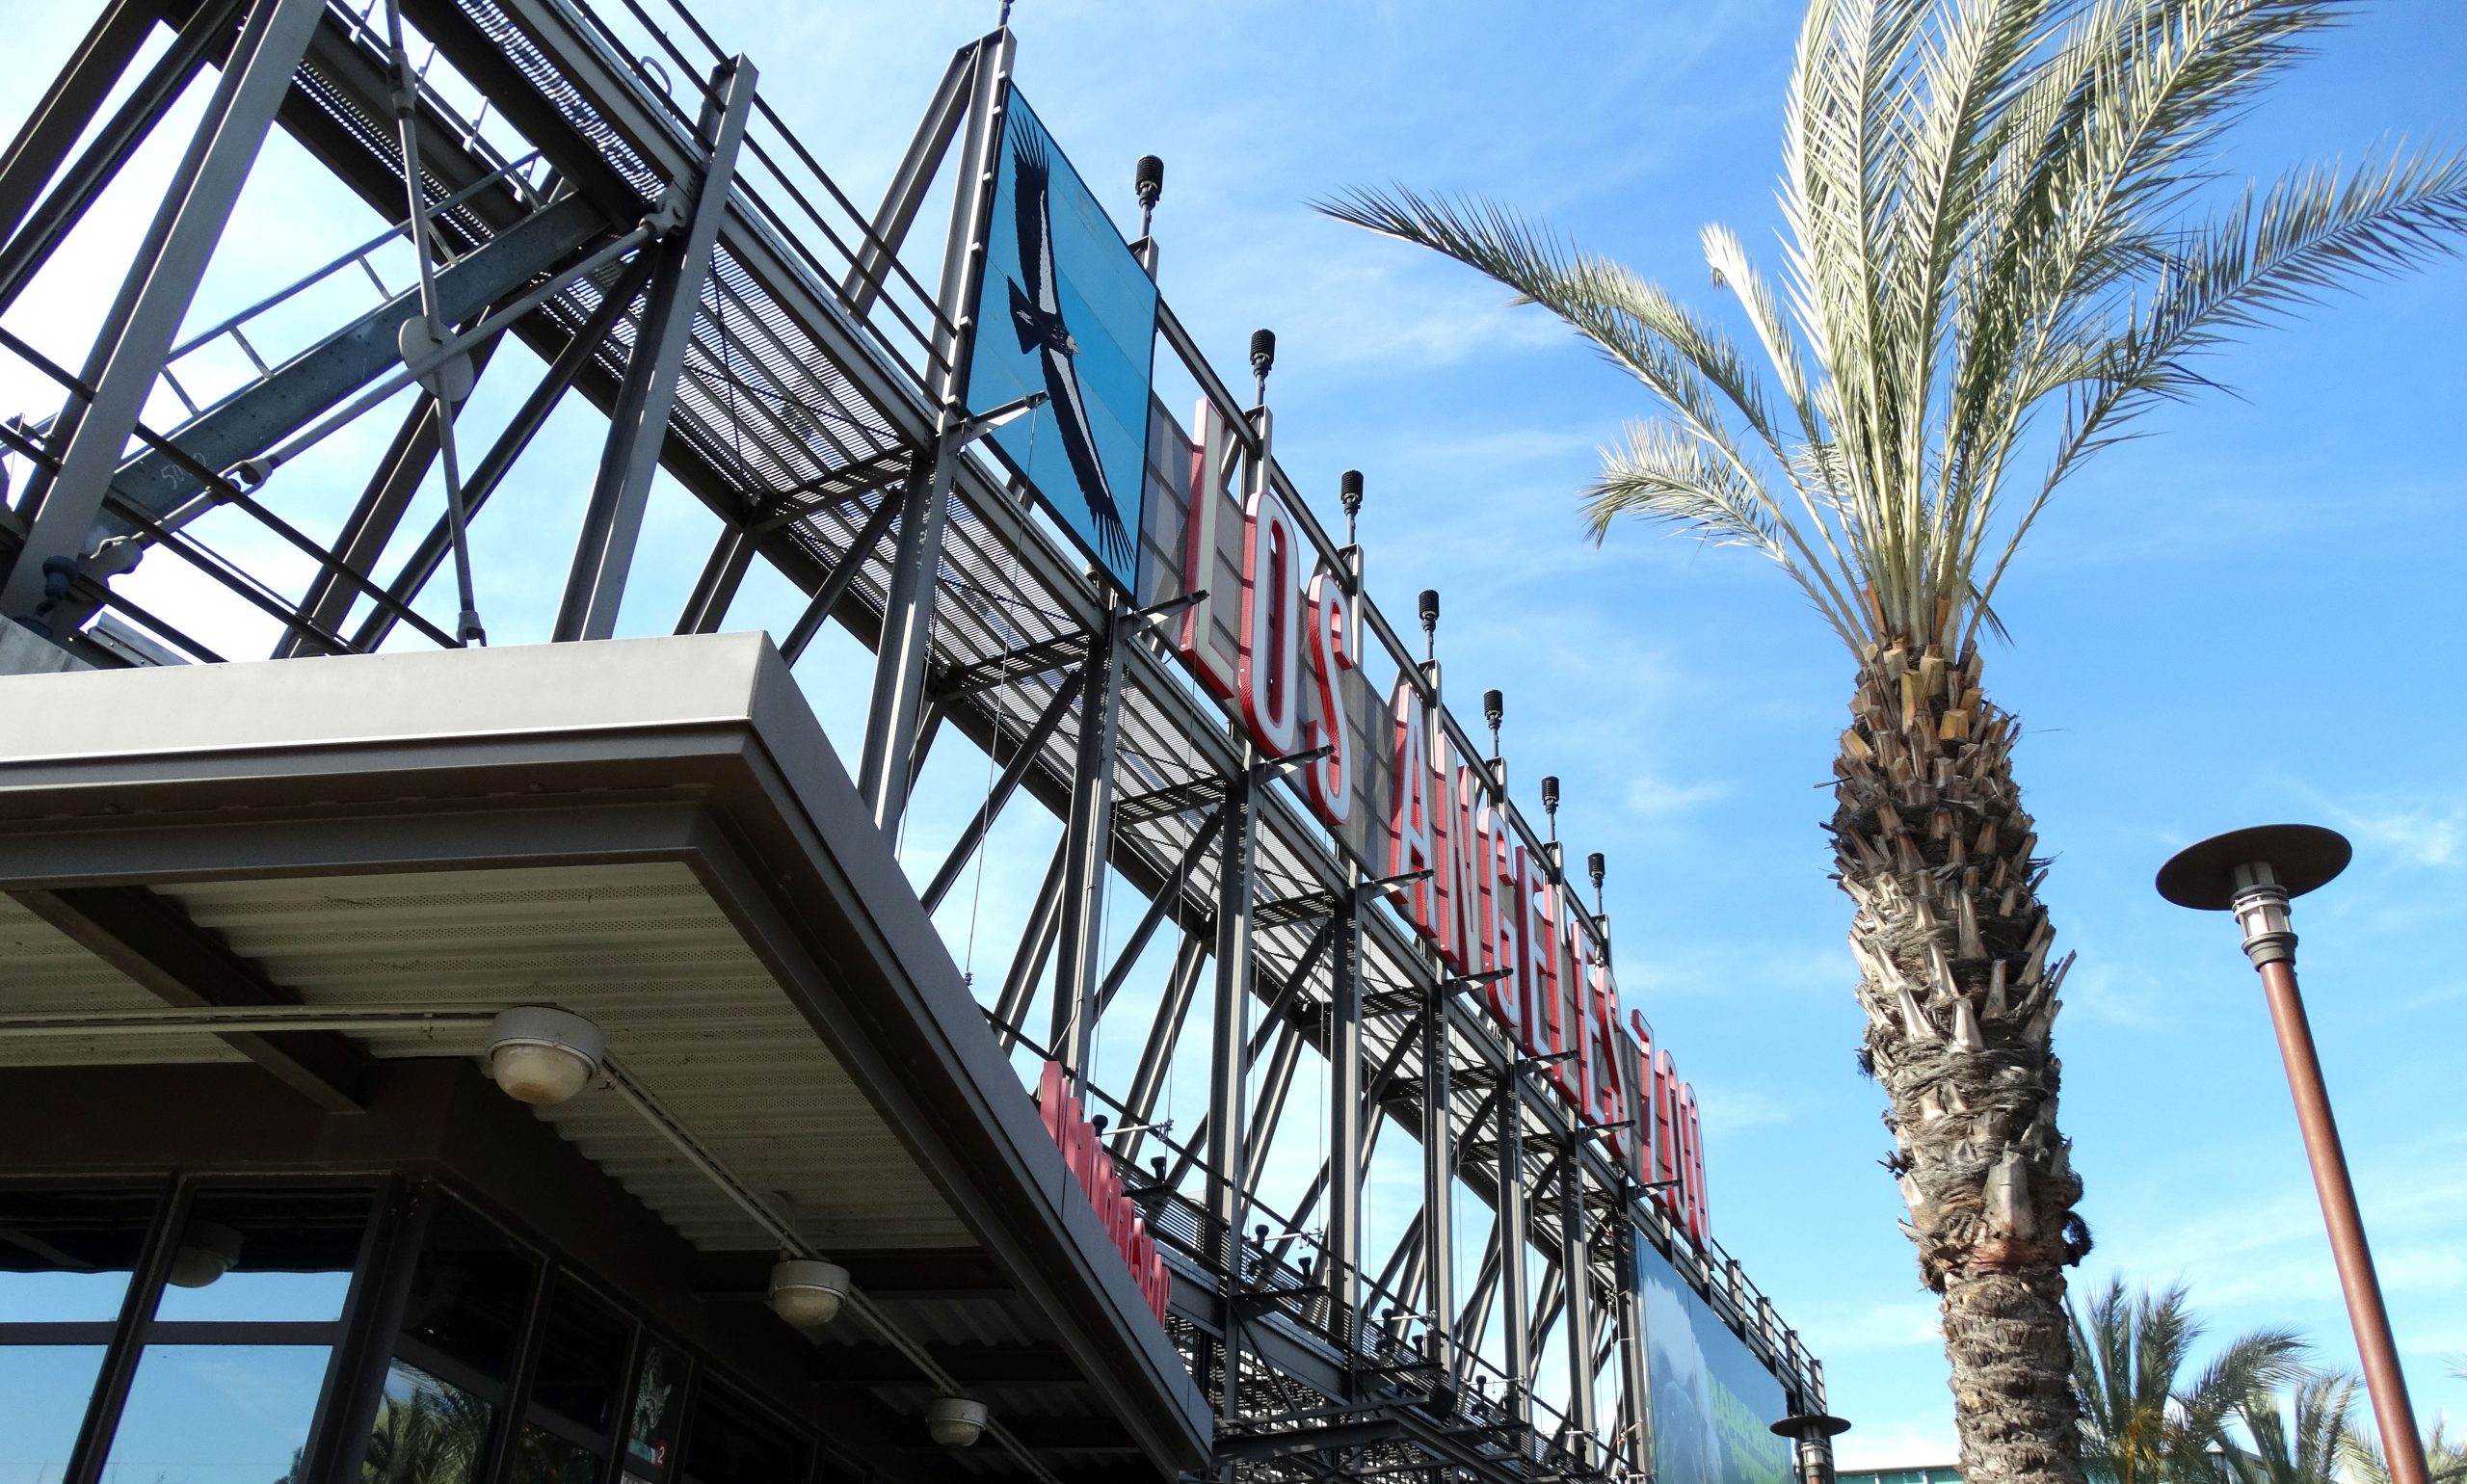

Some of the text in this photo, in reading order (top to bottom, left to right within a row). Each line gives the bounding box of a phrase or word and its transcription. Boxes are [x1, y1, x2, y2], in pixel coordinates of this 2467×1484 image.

[1180, 396, 1711, 1254] LOS ANGELES ZOO
[657, 1446, 665, 1464] 2
